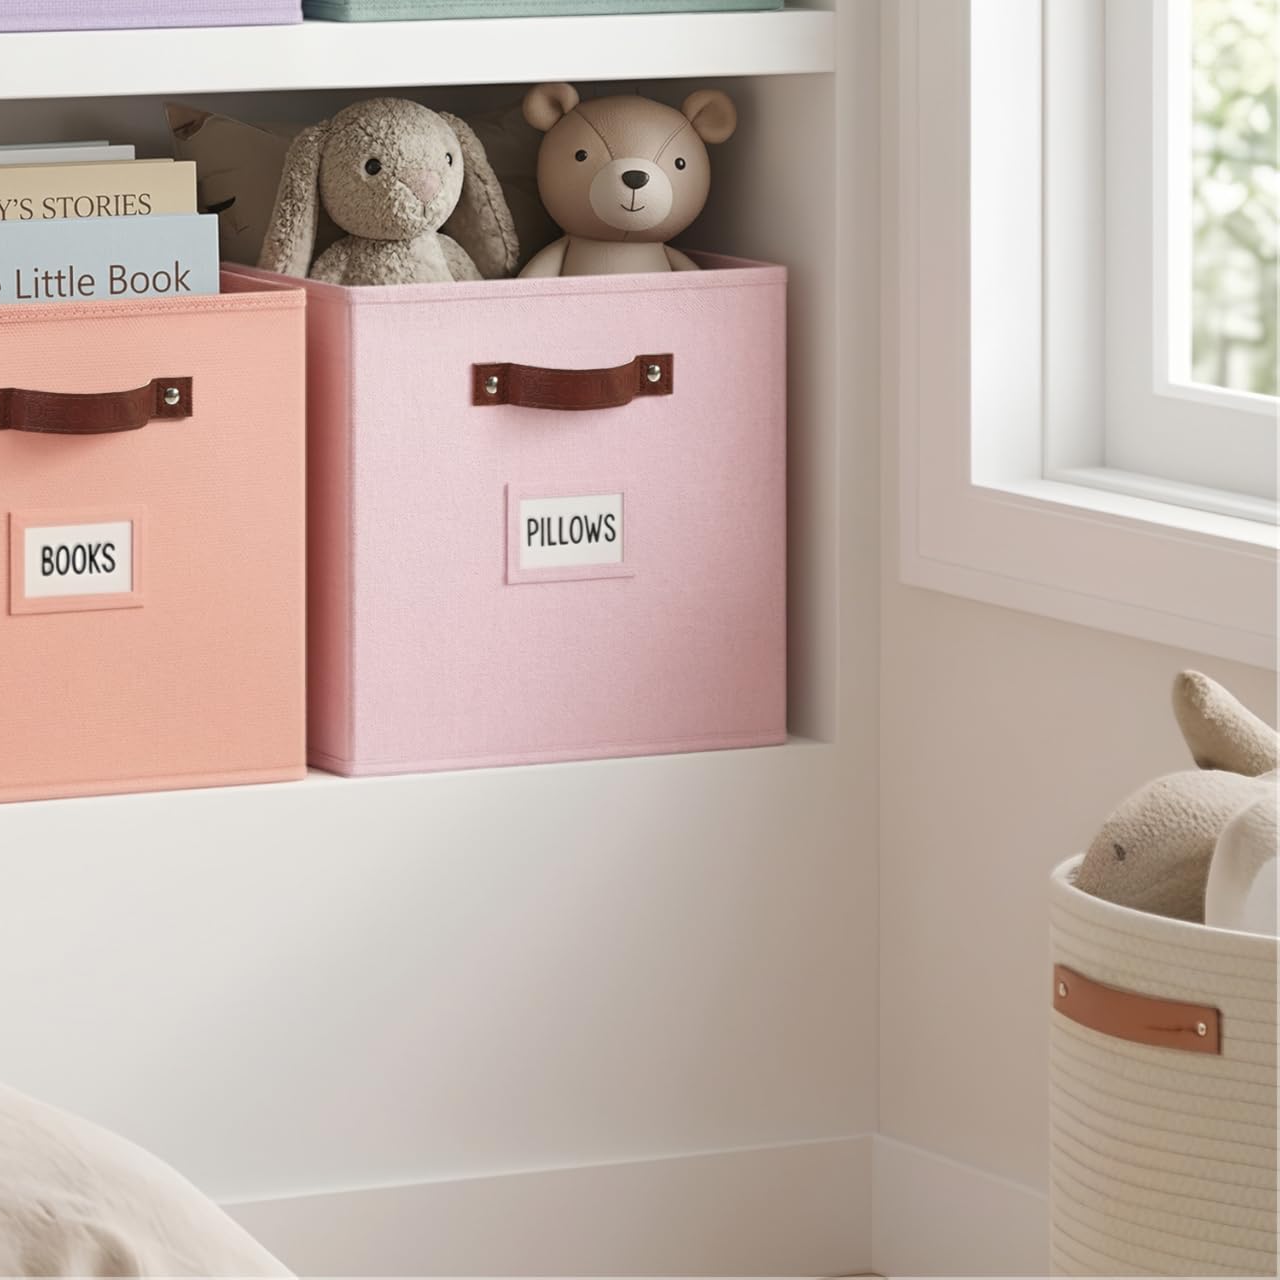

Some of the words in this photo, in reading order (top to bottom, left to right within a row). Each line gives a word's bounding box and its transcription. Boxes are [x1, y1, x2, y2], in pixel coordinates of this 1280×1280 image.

[42, 193, 152, 220] STORIES
[16, 265, 96, 300] Little
[109, 260, 191, 295] Book
[527, 513, 617, 547] PILLOWS
[41, 542, 116, 577] BOOKS
